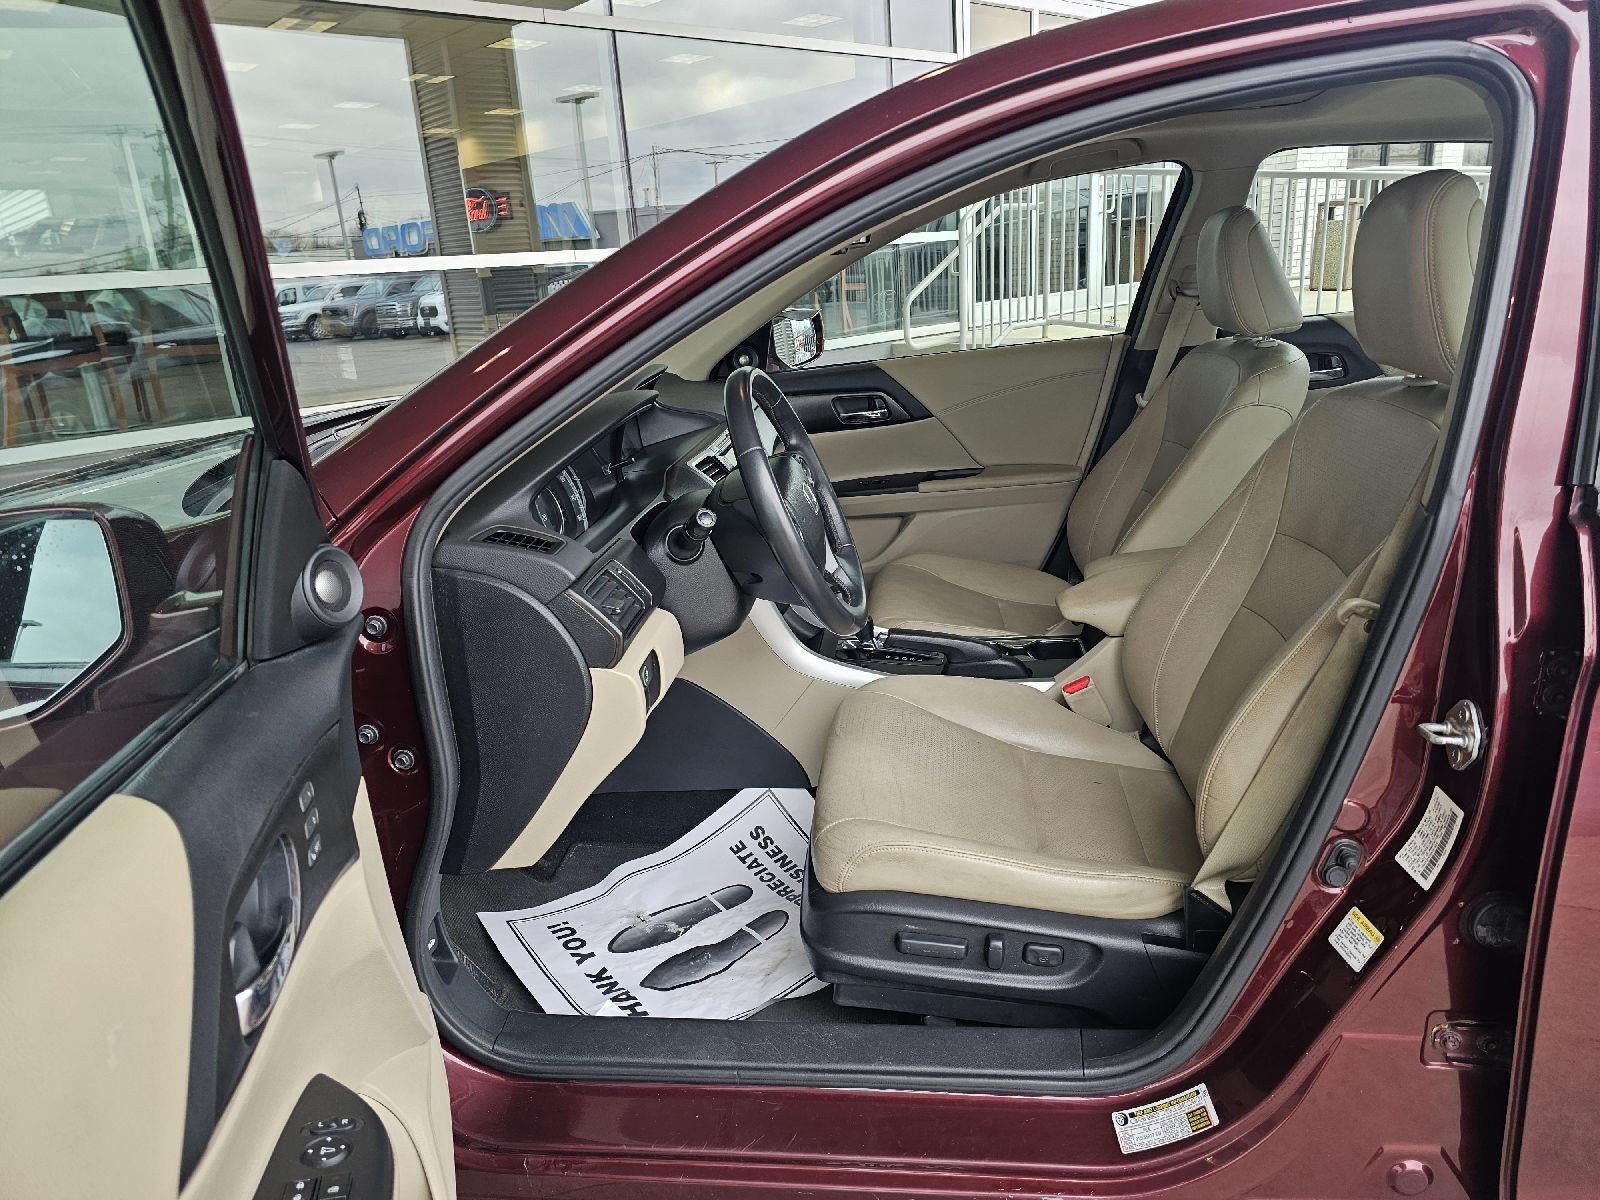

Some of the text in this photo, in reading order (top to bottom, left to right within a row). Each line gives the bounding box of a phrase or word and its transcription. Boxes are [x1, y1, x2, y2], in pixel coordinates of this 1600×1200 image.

[750, 826, 804, 882] SINESS
[547, 921, 649, 1016] HANK YOU!
